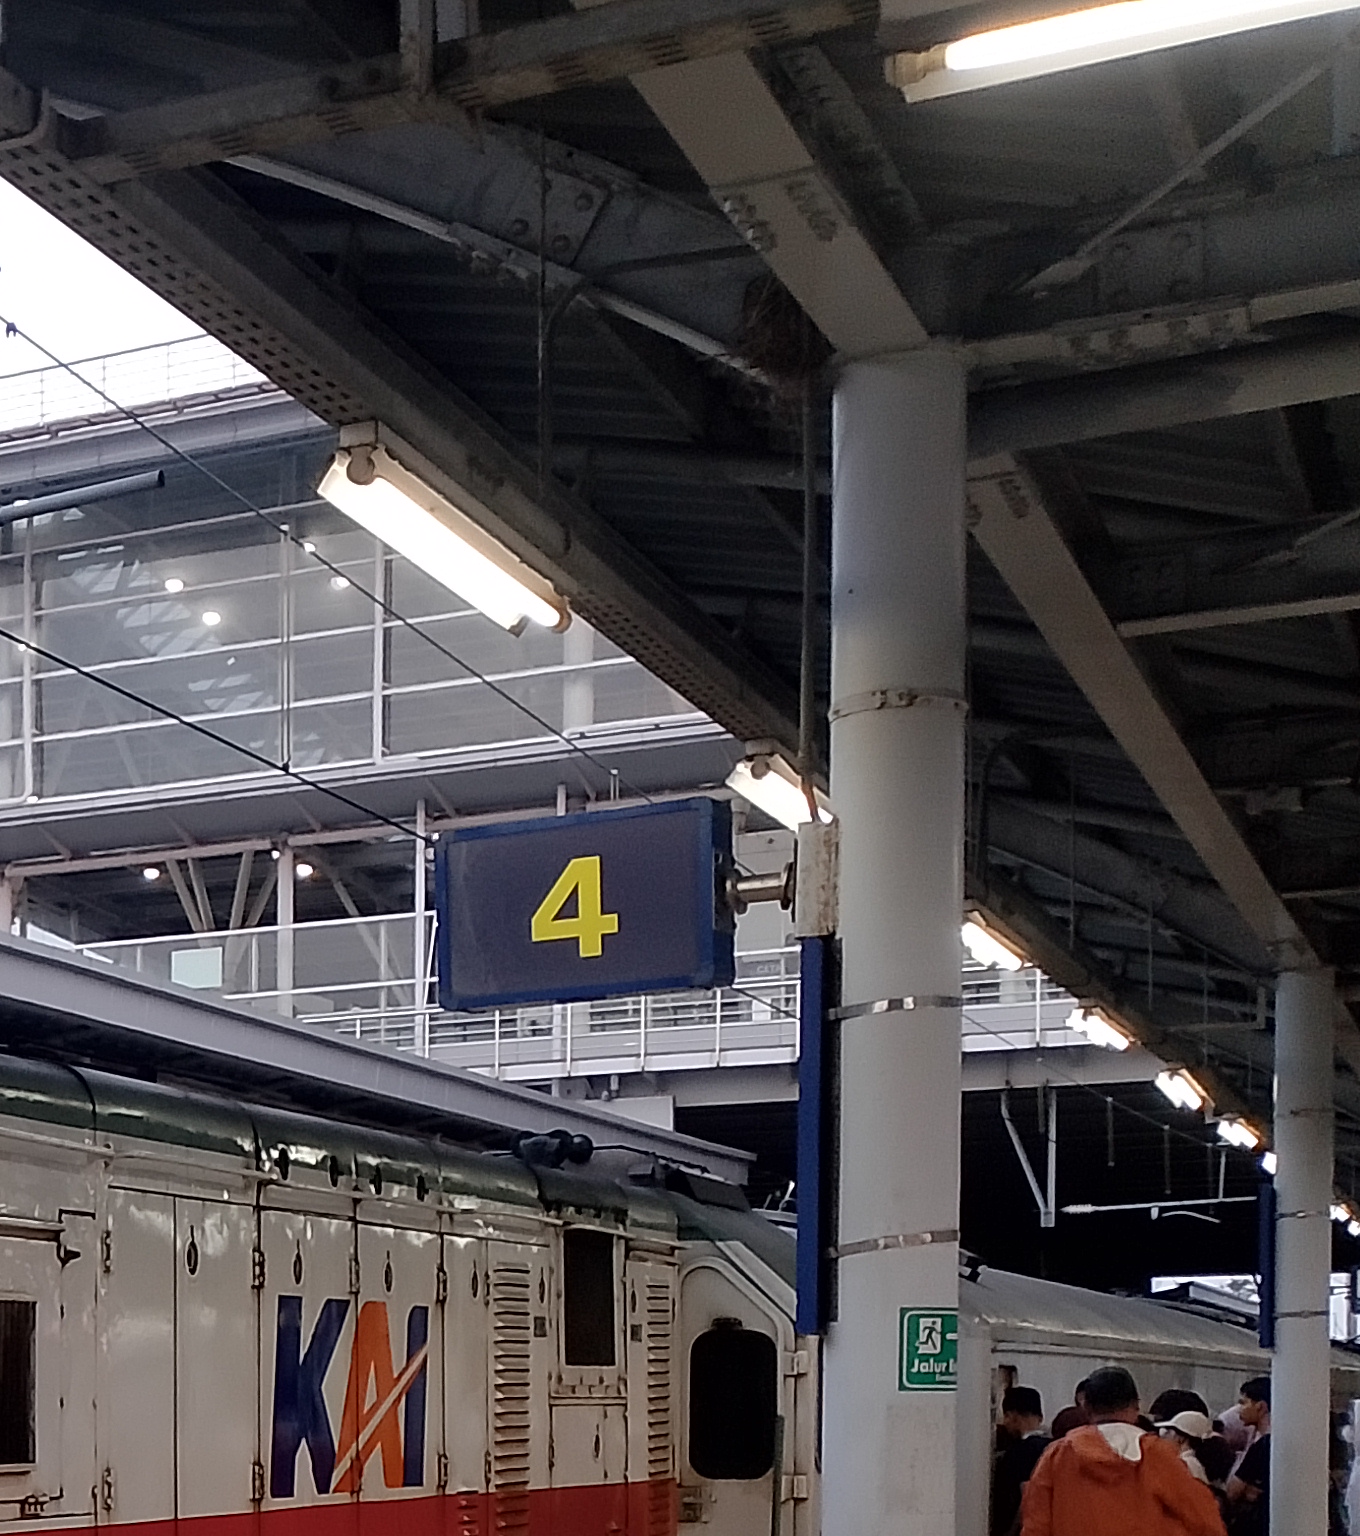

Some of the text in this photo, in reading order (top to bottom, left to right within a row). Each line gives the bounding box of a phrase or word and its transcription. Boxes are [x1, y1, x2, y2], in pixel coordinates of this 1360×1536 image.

[531, 855, 619, 958] 4
[270, 1294, 430, 1498] KAI
[910, 1357, 948, 1374] Jalur
